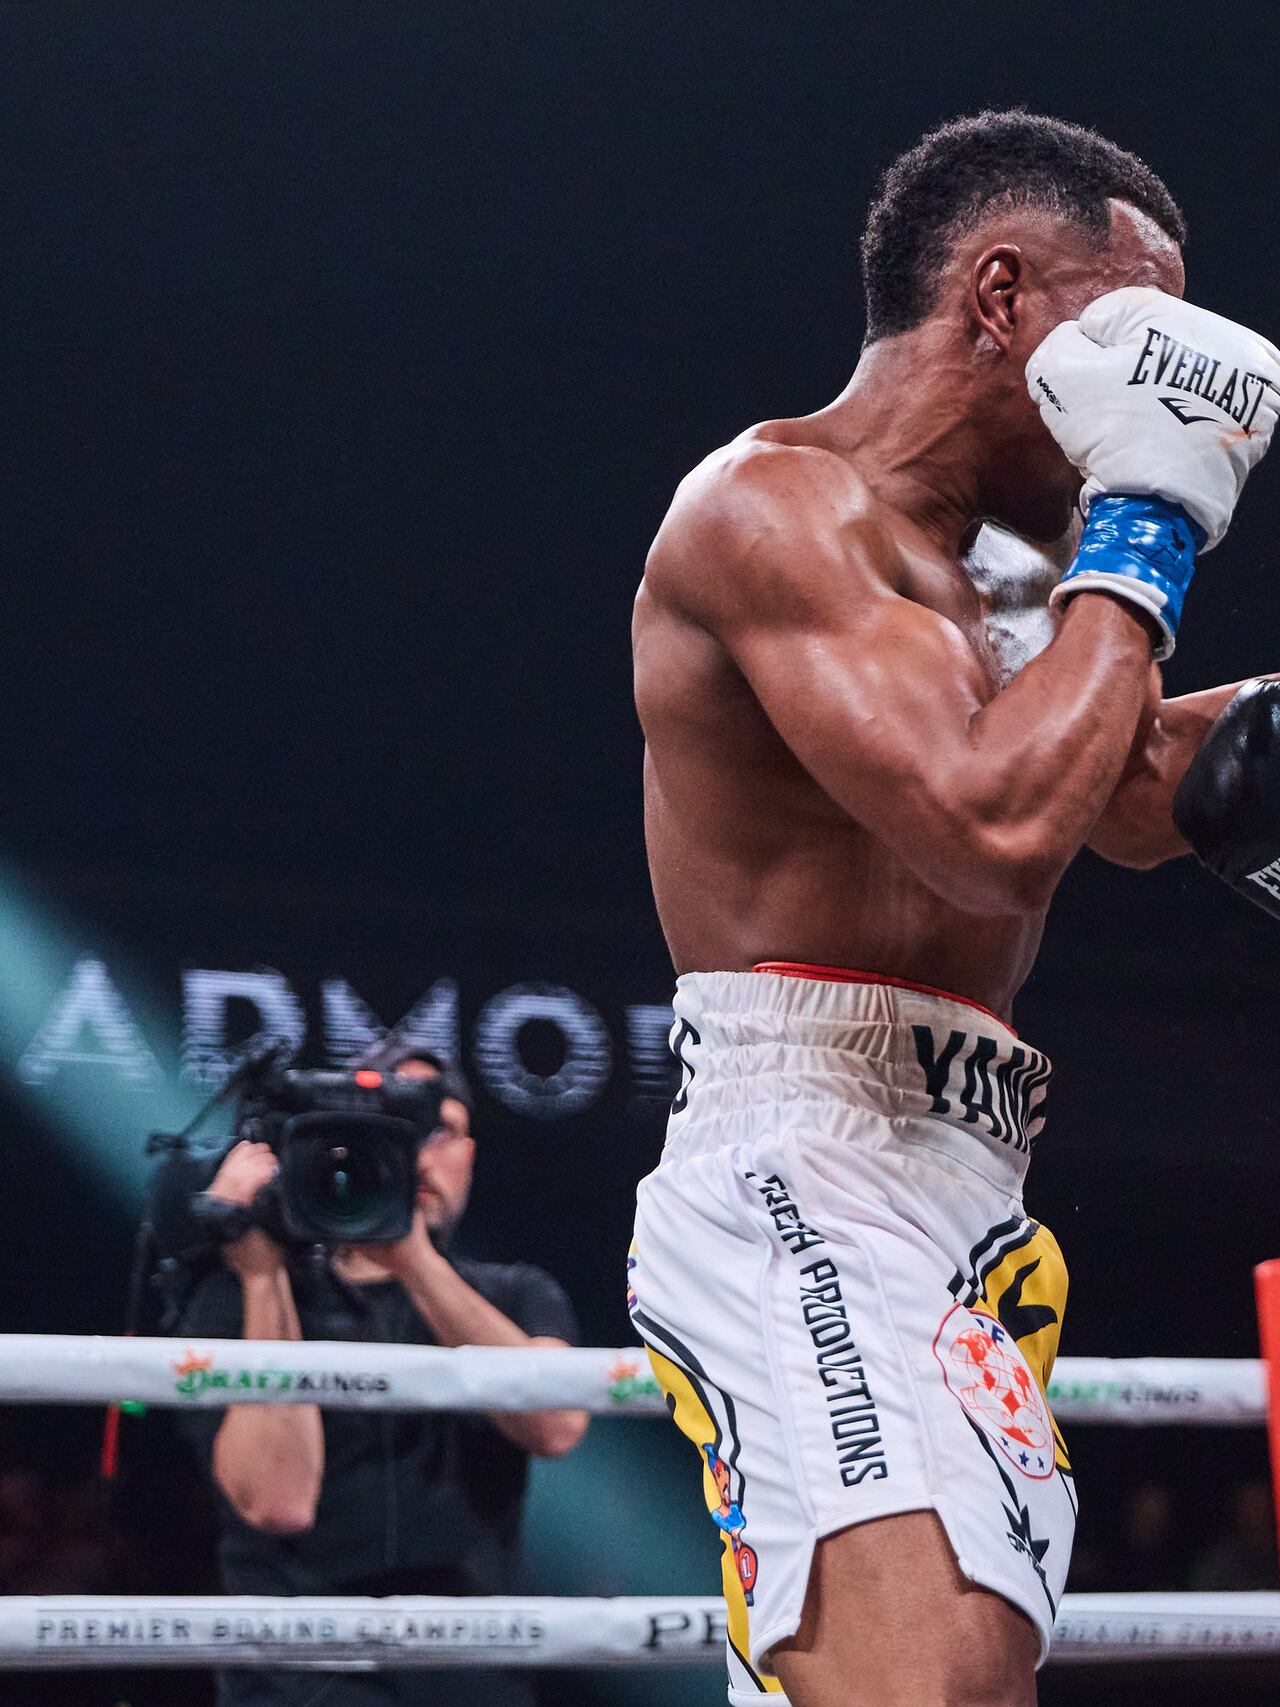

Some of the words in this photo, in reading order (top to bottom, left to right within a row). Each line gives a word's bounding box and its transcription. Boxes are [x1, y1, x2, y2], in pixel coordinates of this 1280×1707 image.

[1127, 327, 1272, 435] EVERLAST
[799, 1257, 888, 1487] PRODUCTIONS
[36, 1618, 191, 1640] PREMIER
[212, 1617, 338, 1641] BOXING
[354, 1617, 545, 1640] CHAMPIONS
